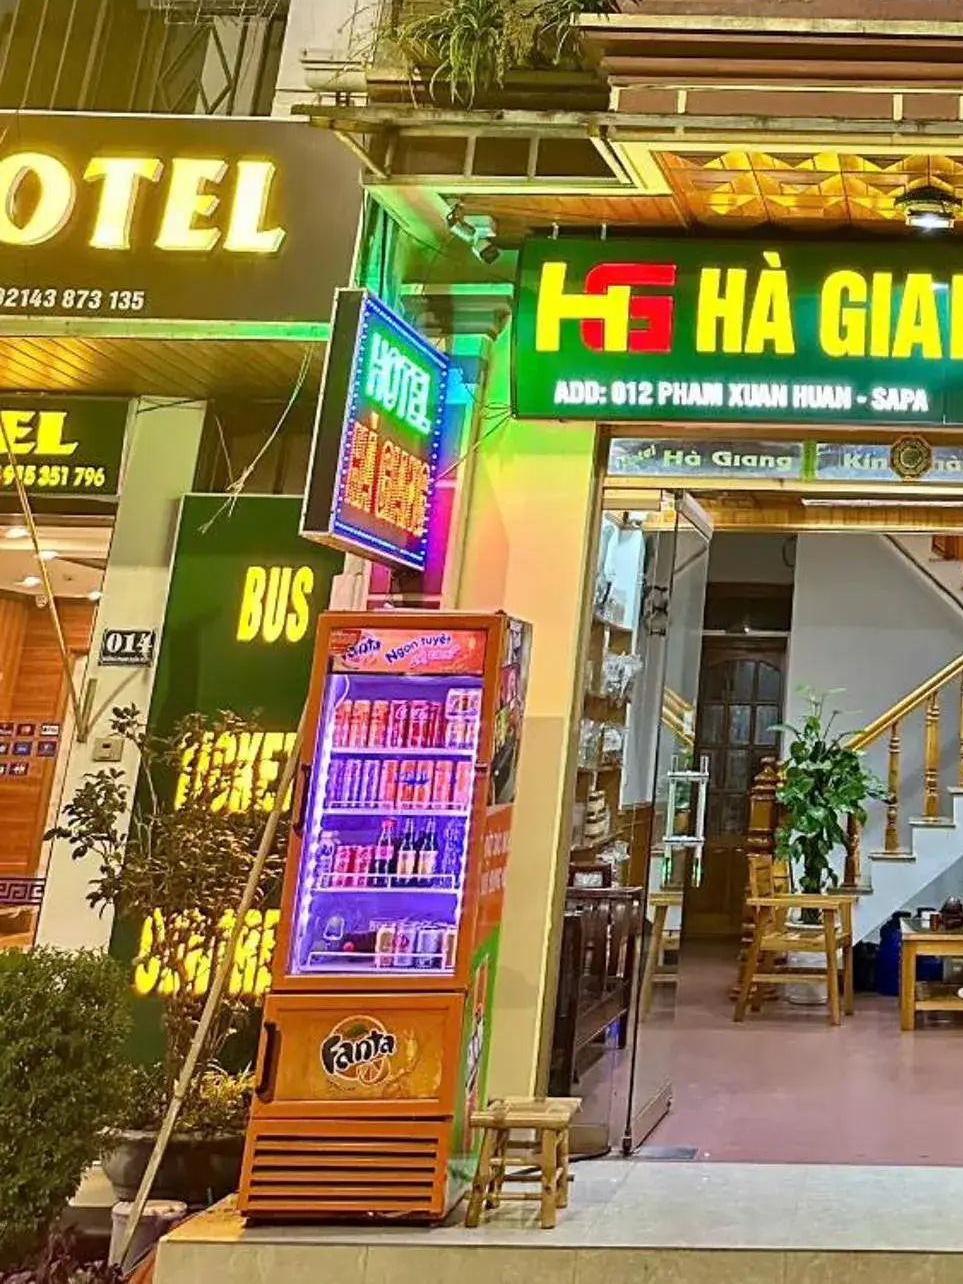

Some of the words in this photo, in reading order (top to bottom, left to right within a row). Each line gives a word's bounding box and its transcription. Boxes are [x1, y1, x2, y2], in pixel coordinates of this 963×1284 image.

[61, 290, 102, 309] 873
[109, 290, 145, 310] 135
[696, 251, 796, 354] HÀ
[365, 331, 432, 435] HOTEL
[554, 380, 607, 405] ADD:
[611, 380, 654, 405] 012
[728, 382, 788, 407] XUAN
[871, 387, 929, 412] SAPA
[73, 466, 105, 487] 796
[237, 565, 314, 643] BUS
[106, 632, 152, 656] 014
[321, 1030, 396, 1076] Fanta
